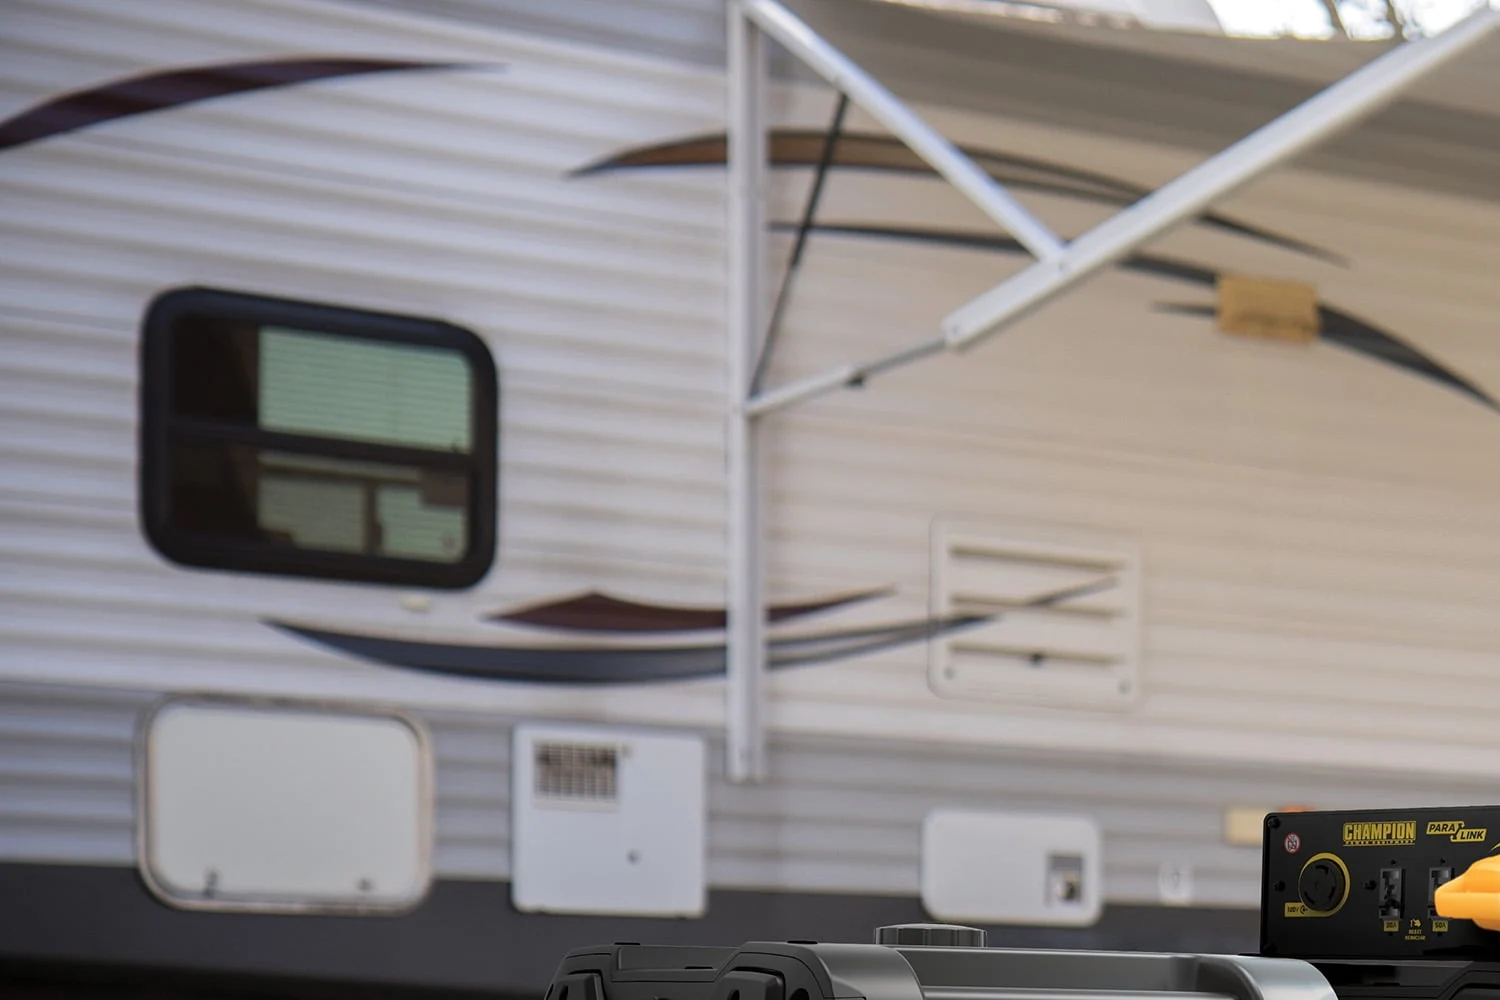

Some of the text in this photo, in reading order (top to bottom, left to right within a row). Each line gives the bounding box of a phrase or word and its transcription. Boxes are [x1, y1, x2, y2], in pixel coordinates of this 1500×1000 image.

[1344, 822, 1415, 841] CHAMPION
[1428, 823, 1456, 833] PARA
[1459, 830, 1485, 840] LINK
